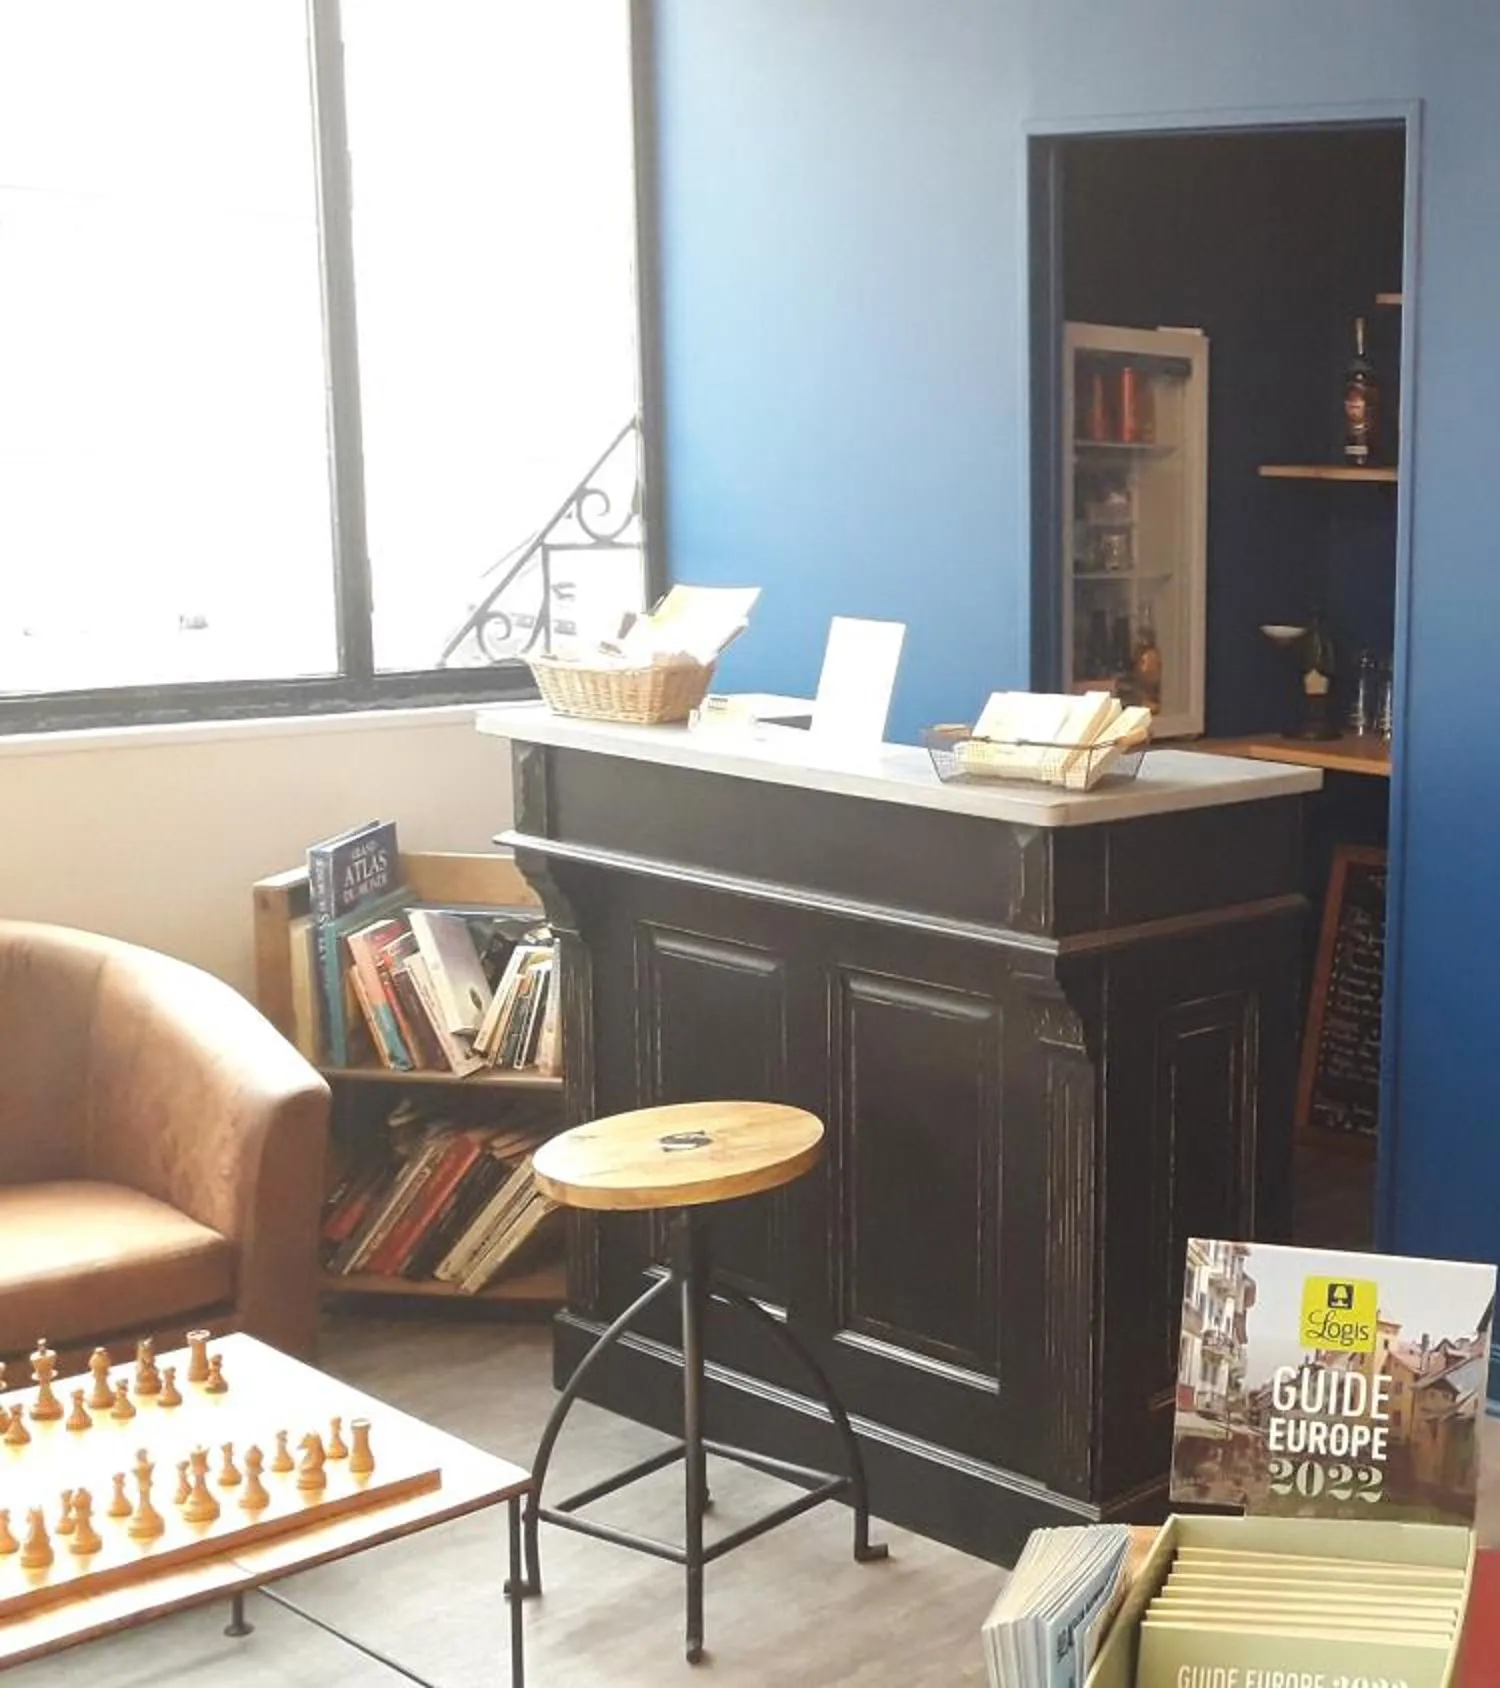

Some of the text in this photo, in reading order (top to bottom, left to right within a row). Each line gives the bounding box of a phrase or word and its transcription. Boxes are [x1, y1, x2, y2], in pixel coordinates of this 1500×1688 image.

[344, 851, 388, 889] ATLAS
[1306, 1310, 1369, 1346] Logis
[1273, 1366, 1392, 1419] GUIDE
[1268, 1418, 1388, 1460] EUROPE
[1268, 1461, 1384, 1503] 2022
[1177, 1665, 1239, 1688] GUIDE
[1245, 1669, 1326, 1688] EUROPE
